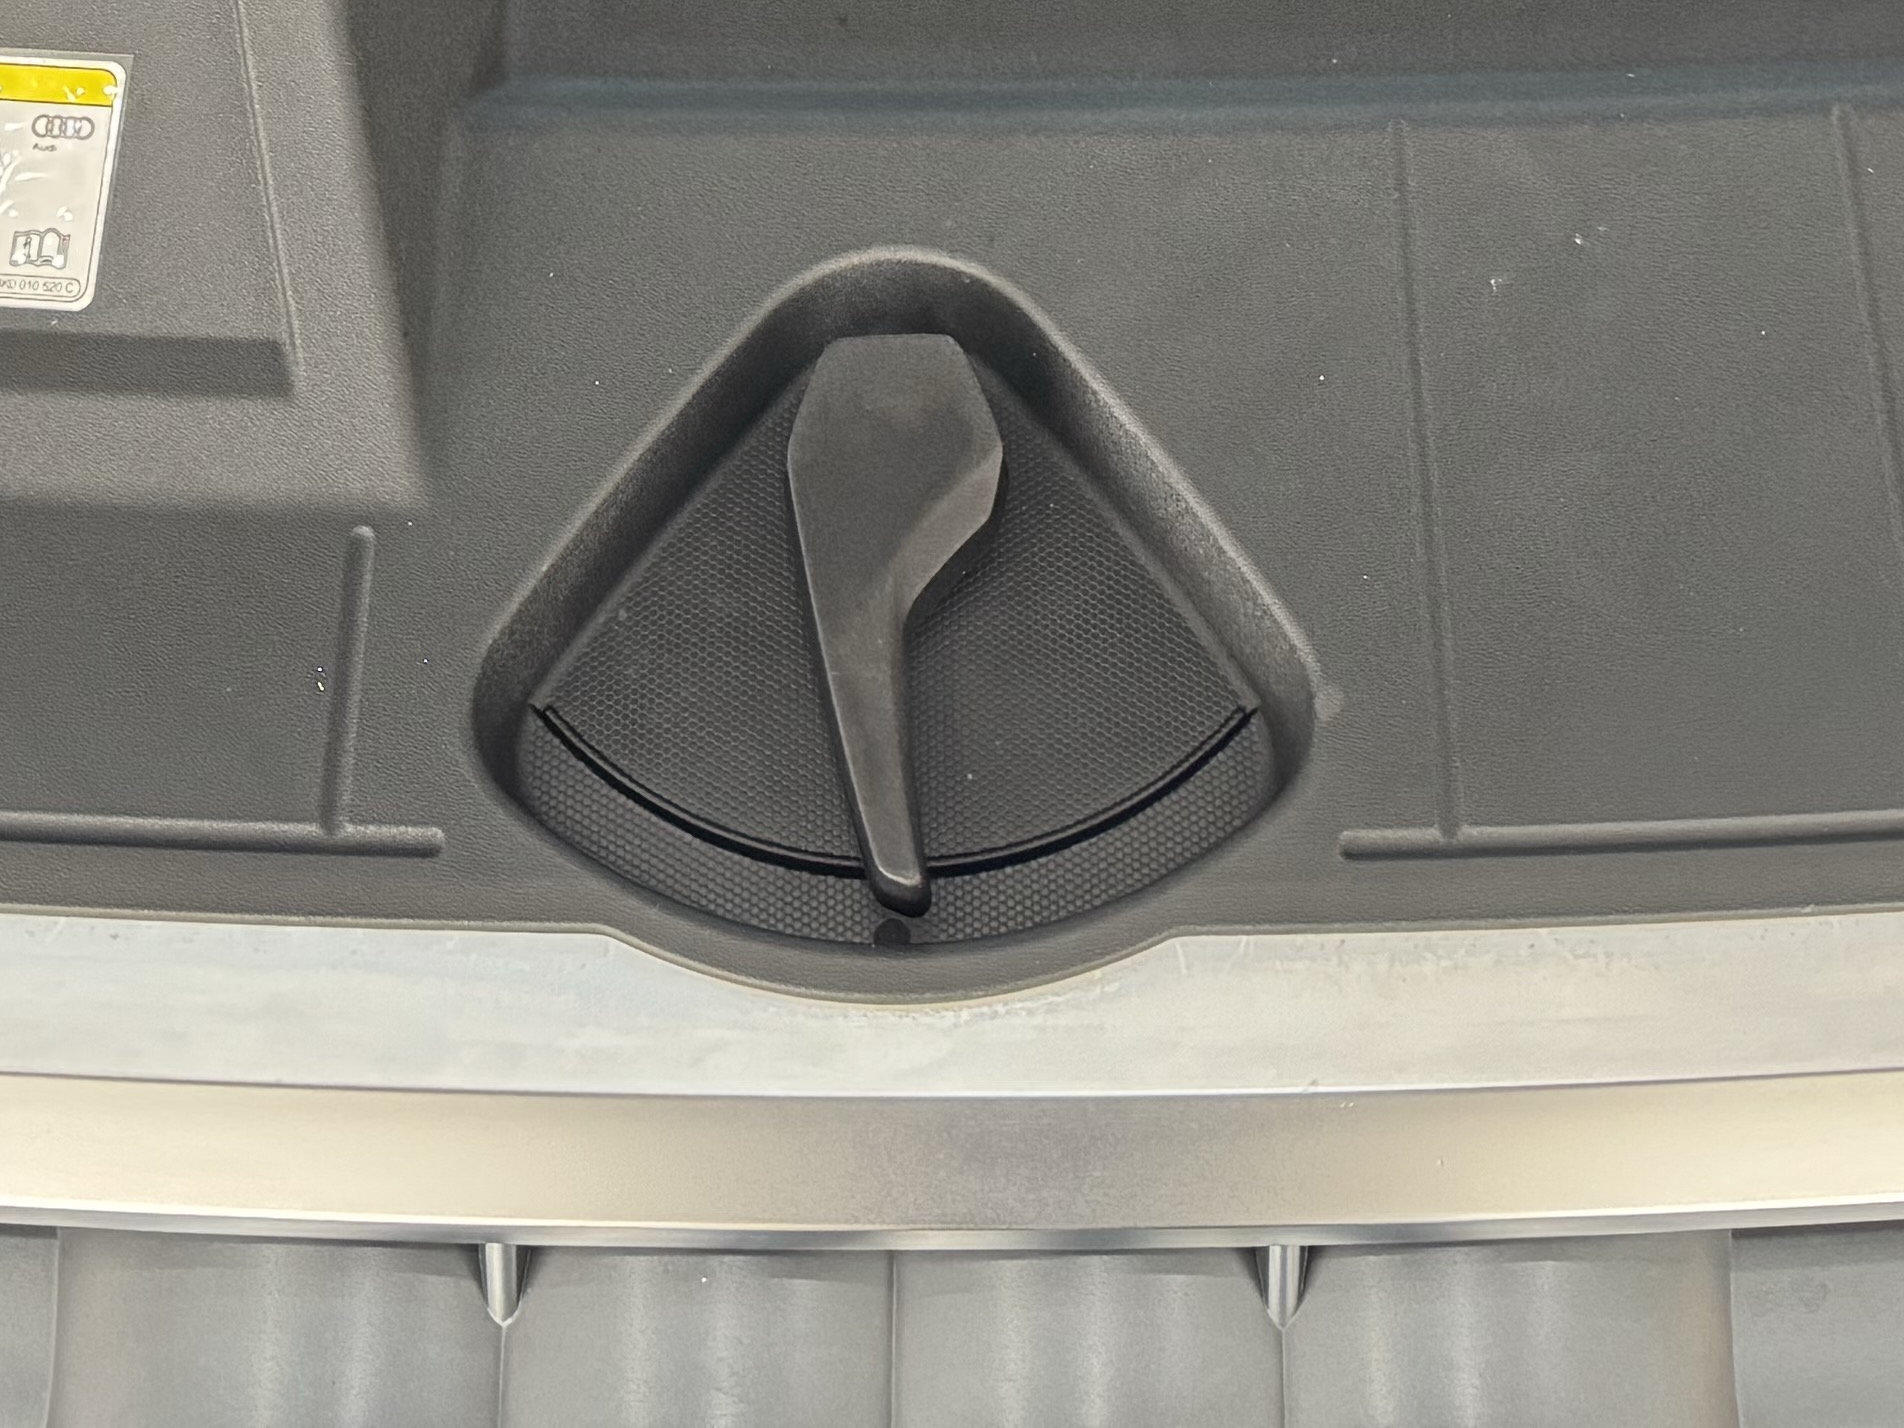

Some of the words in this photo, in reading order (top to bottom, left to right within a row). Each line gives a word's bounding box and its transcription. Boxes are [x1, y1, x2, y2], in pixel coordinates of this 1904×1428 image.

[18, 279, 40, 291] 010
[42, 281, 63, 293] 520
[65, 281, 75, 294] C
